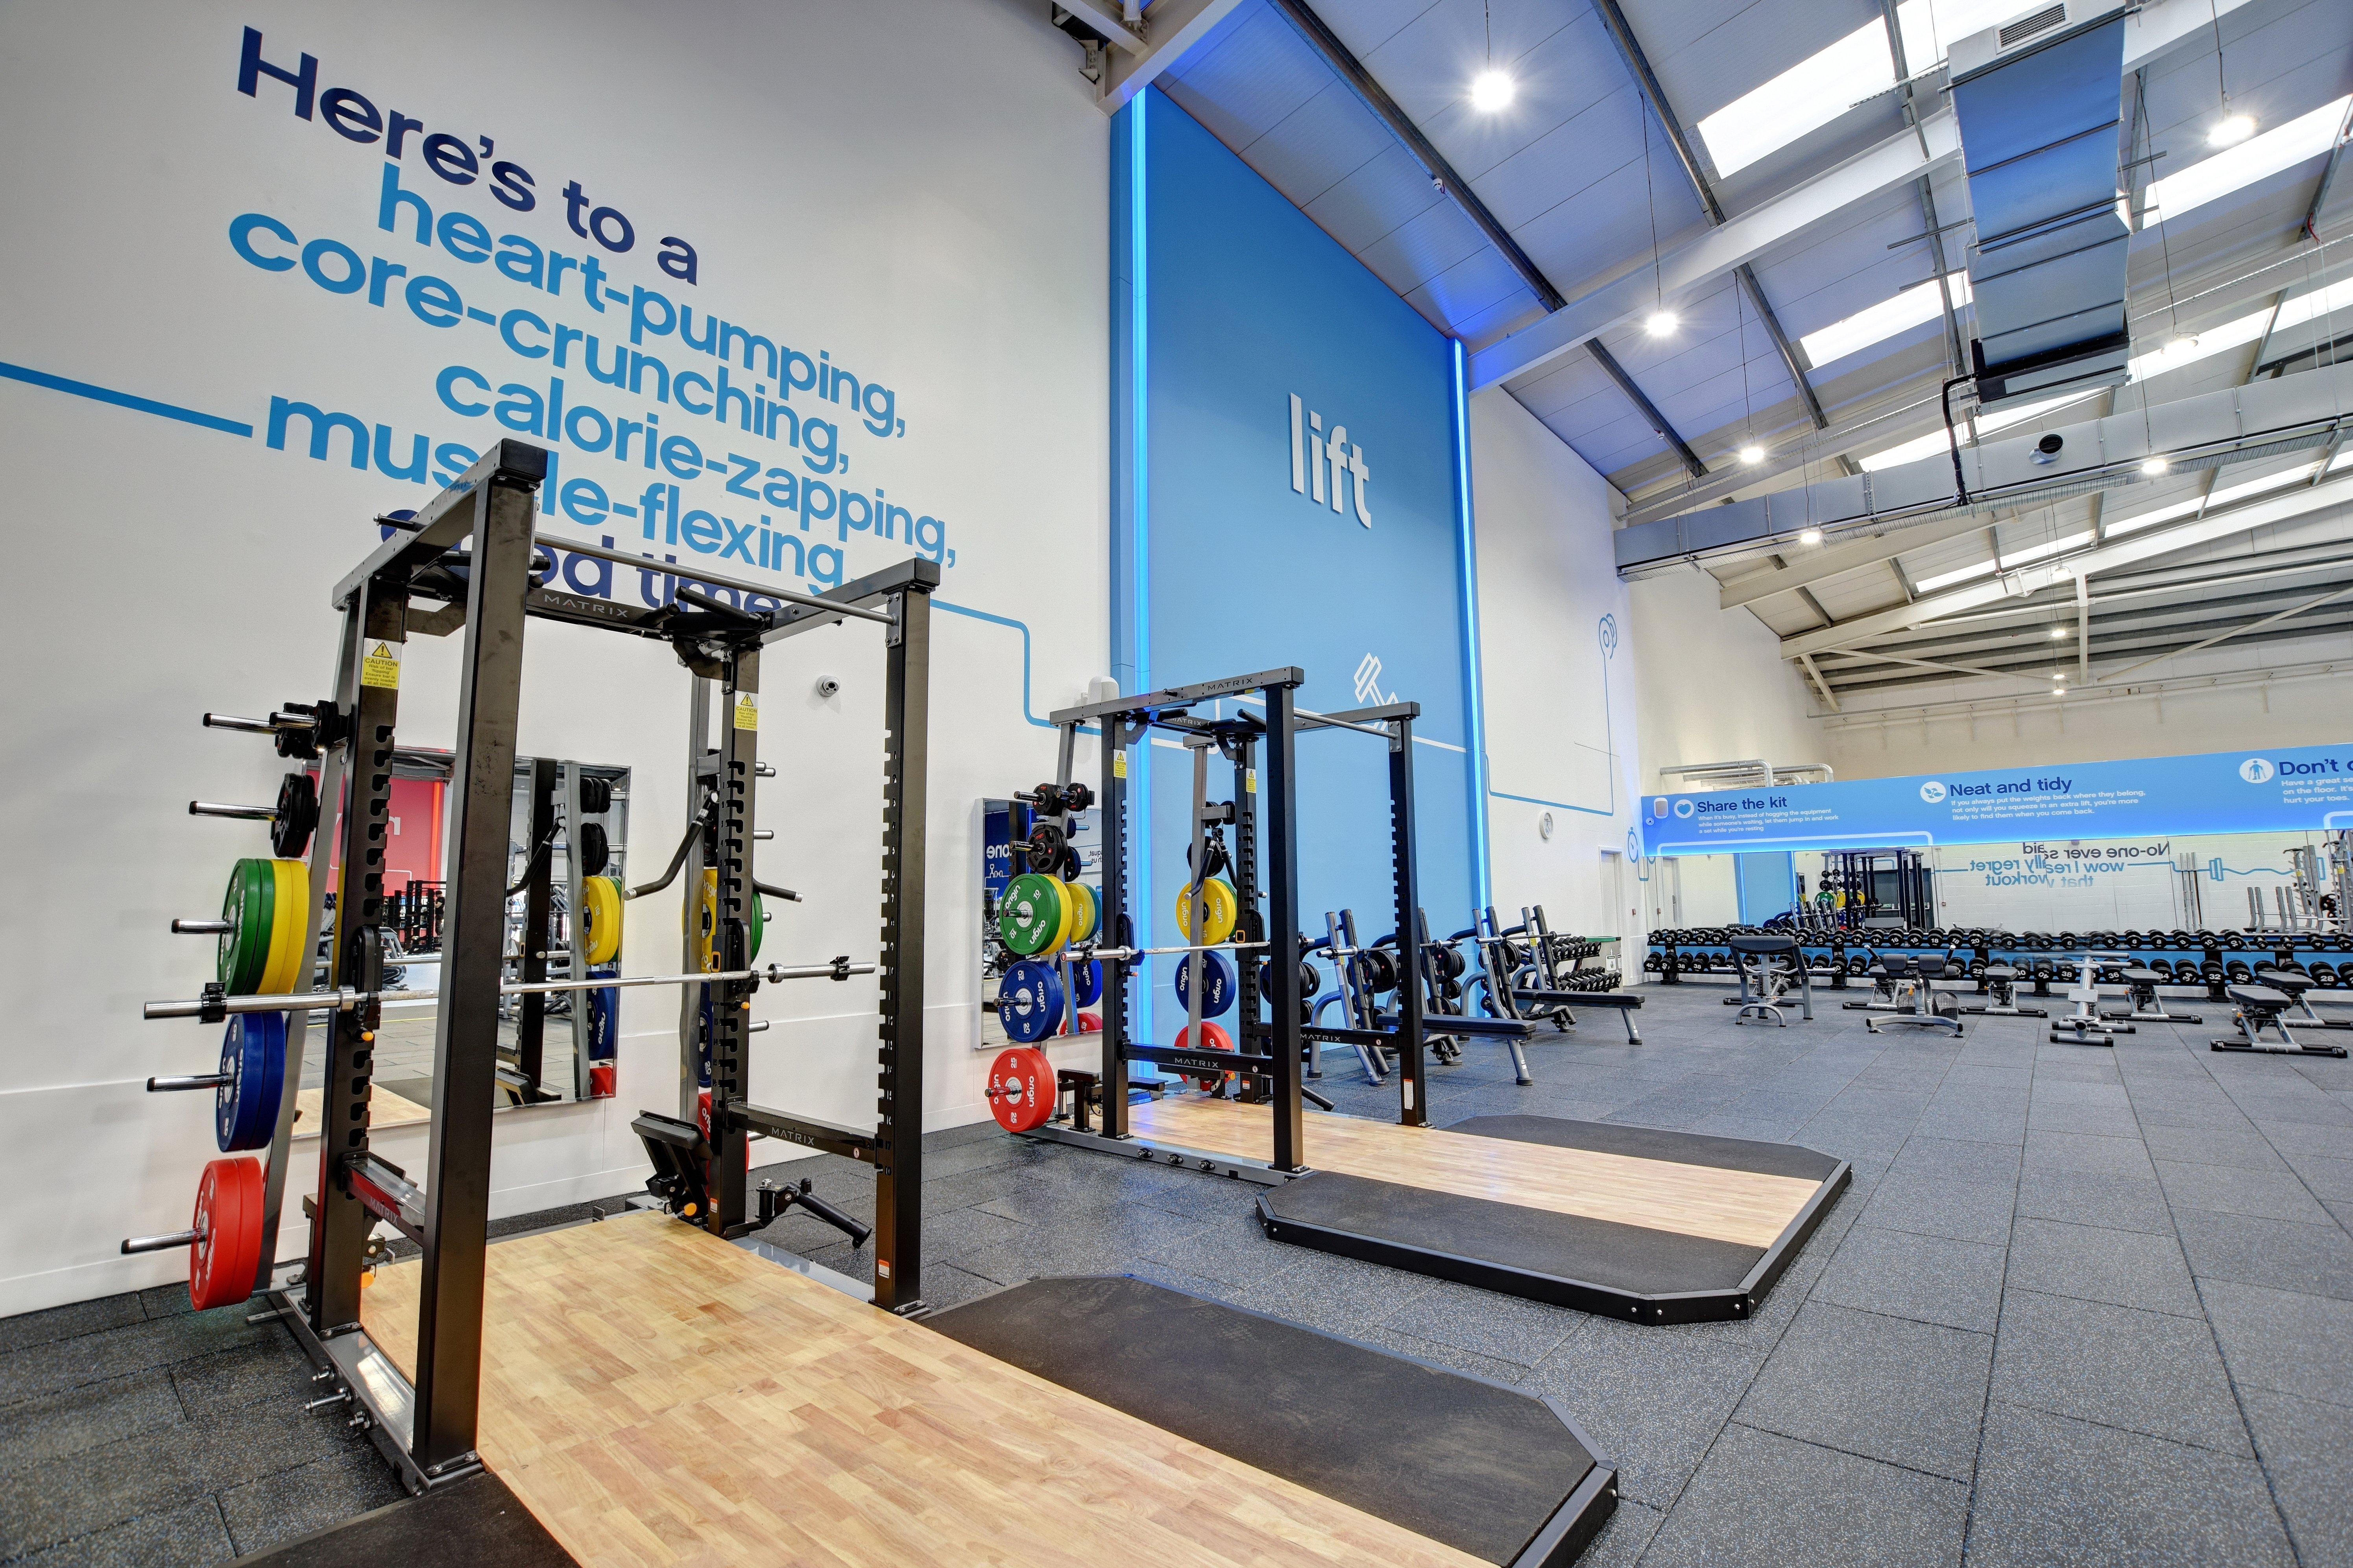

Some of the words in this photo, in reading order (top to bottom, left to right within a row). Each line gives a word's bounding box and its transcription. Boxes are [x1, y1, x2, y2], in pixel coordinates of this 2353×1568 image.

[237, 25, 536, 212] Here's
[563, 179, 635, 253] to
[657, 236, 698, 286] a
[378, 161, 906, 438] heart-pumping,
[228, 213, 849, 474] core-crunching,
[436, 365, 957, 568] calorie-zapping,
[1290, 392, 1372, 529] lift
[265, 395, 855, 596] musle-flexing
[544, 594, 628, 619] MATRIX
[365, 658, 398, 667] CAUTION
[1208, 678, 1253, 691] MATRIX
[1170, 718, 1202, 726] MATRIX
[2279, 758, 2339, 775] Don't
[1950, 783, 1992, 797] Neat
[1997, 778, 2031, 793] and
[2037, 777, 2072, 793] tidy
[2316, 777, 2340, 786] great
[1697, 801, 1738, 812] Share
[1742, 798, 1765, 810] the
[1770, 797, 1787, 808] kit
[1005, 885, 1021, 909] origin
[1033, 889, 1041, 900] 10
[1008, 927, 1017, 939] 10
[1029, 920, 1045, 944] origin
[1018, 970, 1024, 981] 20
[1037, 981, 1045, 1012] origin
[1213, 978, 1222, 1004] origin
[1023, 1022, 1030, 1034] 20
[1300, 1033, 1341, 1042] MATRIX
[1011, 1057, 1017, 1068] 25
[1175, 1057, 1219, 1068] MATRIX
[1010, 1112, 1017, 1124] 25
[772, 1127, 814, 1146] MATRIX
